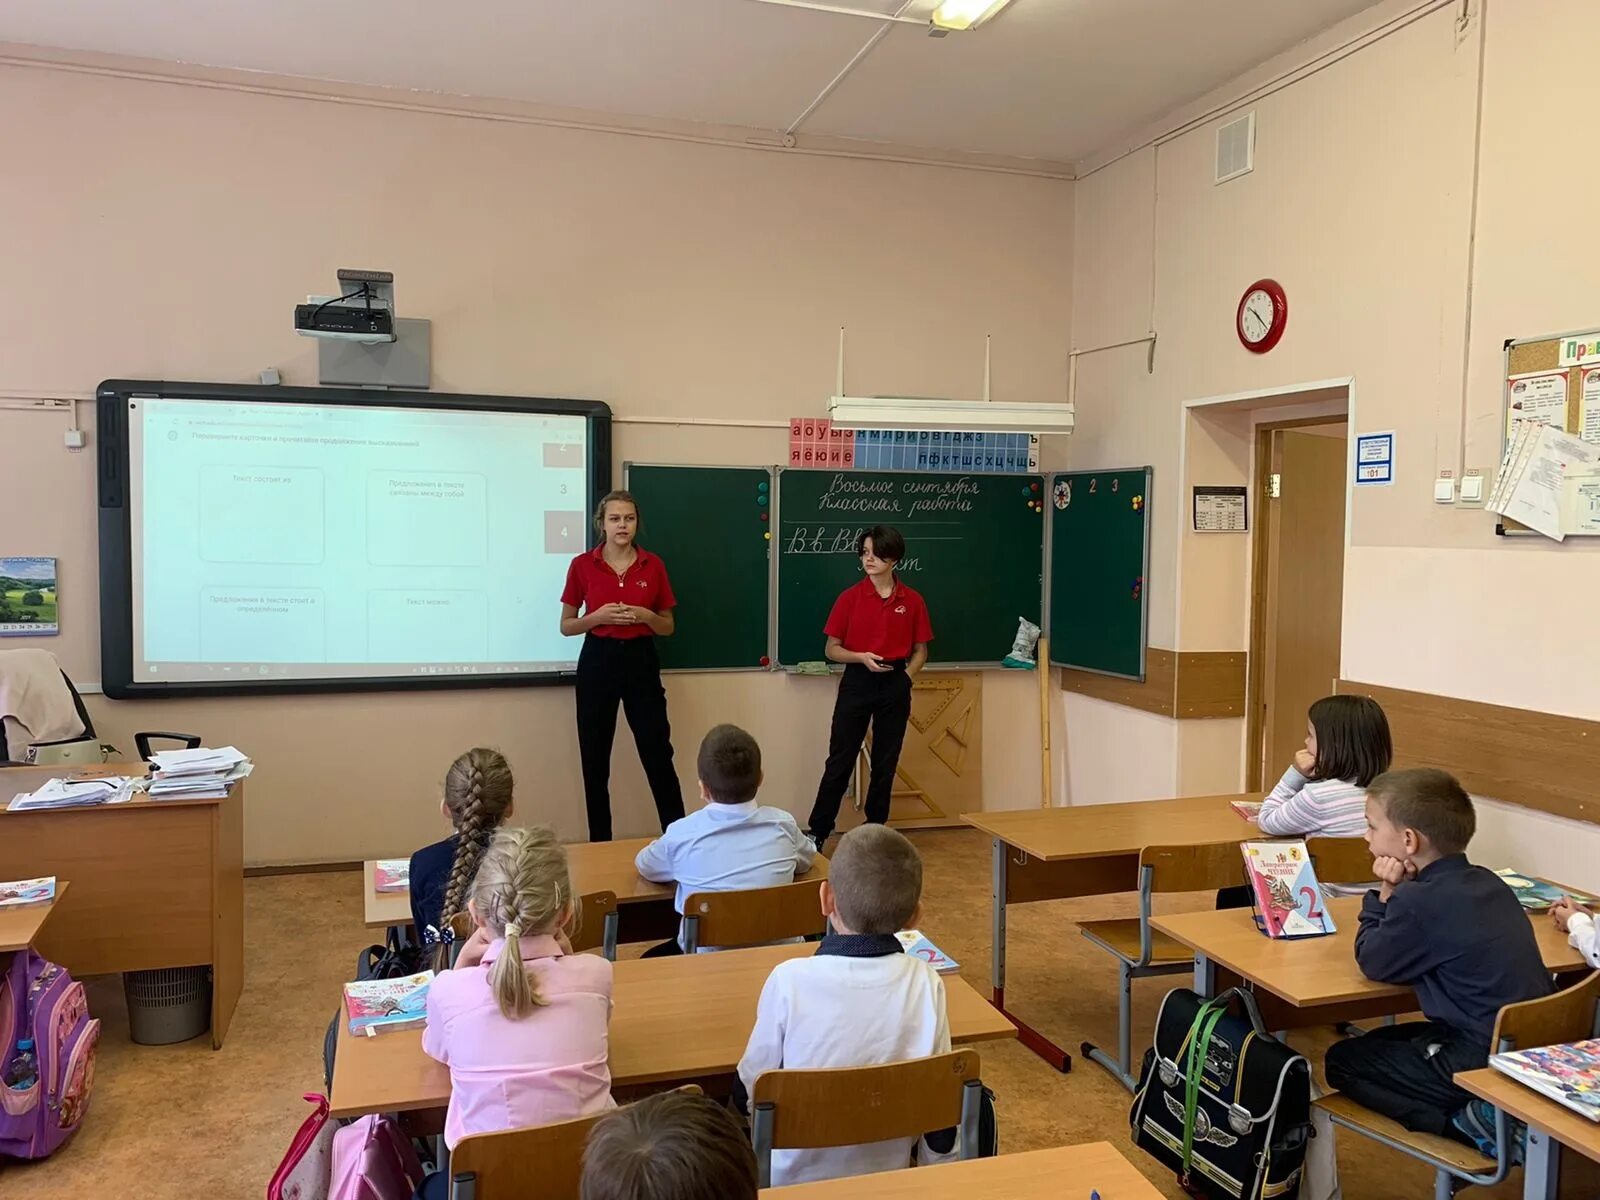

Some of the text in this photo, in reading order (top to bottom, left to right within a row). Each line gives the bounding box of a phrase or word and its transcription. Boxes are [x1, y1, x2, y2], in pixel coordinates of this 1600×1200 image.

[560, 484, 568, 494] 3
[829, 473, 980, 500] Восьмое сентября
[1089, 478, 1097, 493] 2
[1112, 478, 1119, 492] 3
[819, 492, 973, 518] Классная работа
[560, 527, 568, 537] 4
[1300, 886, 1324, 919] 2
[916, 948, 945, 964] 2
